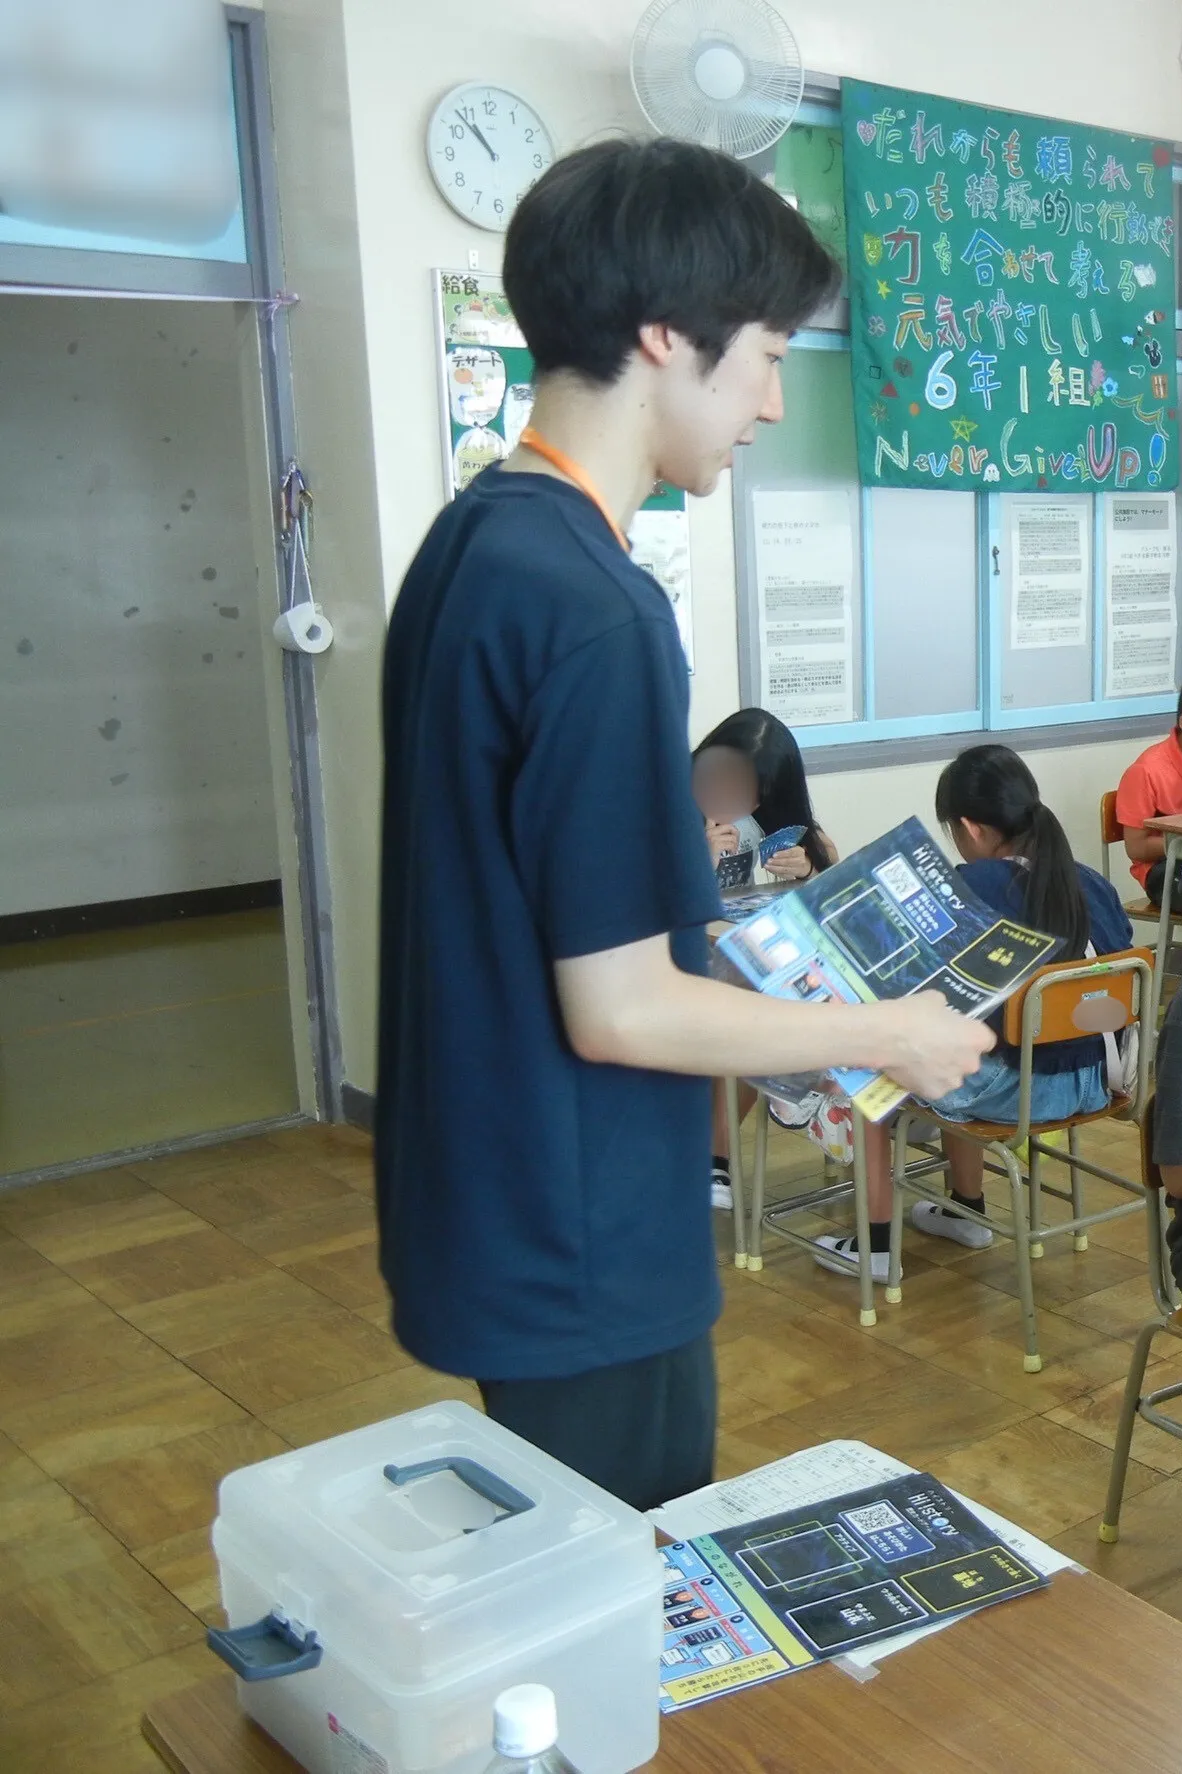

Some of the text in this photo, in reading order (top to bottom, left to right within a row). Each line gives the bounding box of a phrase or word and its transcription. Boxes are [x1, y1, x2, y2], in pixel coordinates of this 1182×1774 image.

[461, 105, 475, 121] 11
[482, 100, 497, 116] 12
[509, 111, 516, 125] 1
[448, 124, 465, 140] 10
[524, 128, 534, 143] 2
[444, 146, 455, 161] 9
[533, 153, 543, 169] 3
[455, 171, 466, 187] 8
[473, 190, 483, 205] 7
[493, 199, 504, 214] 6
[441, 274, 480, 297] 給食
[893, 289, 1102, 358] 元気でやさしい
[451, 353, 502, 368] デザート
[924, 350, 1090, 414] 6年1組
[874, 417, 1167, 488] Never Give Up!
